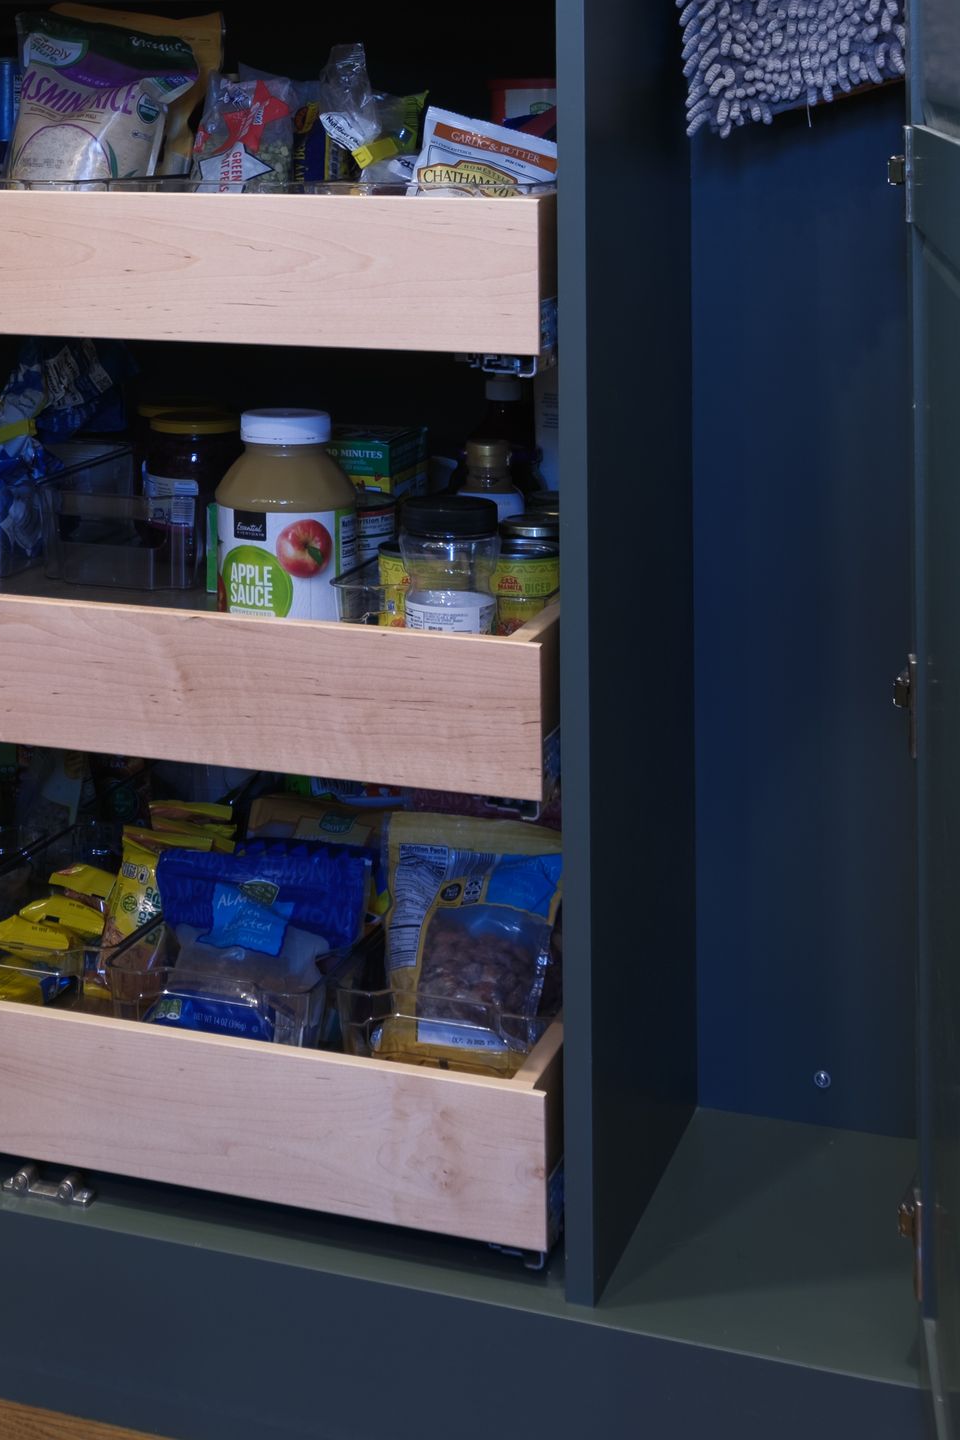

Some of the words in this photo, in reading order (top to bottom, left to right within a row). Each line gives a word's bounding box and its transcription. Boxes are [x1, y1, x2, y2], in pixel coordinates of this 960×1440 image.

[451, 131, 490, 149] GARLIC
[488, 143, 497, 152] &
[499, 145, 541, 164] BUTTER
[231, 151, 243, 182] GREEN
[340, 449, 384, 460] MINUTES
[237, 521, 263, 533] Essential
[231, 562, 273, 587] APPLE
[231, 582, 274, 608] SAUCE
[193, 1012, 204, 1021] NET
